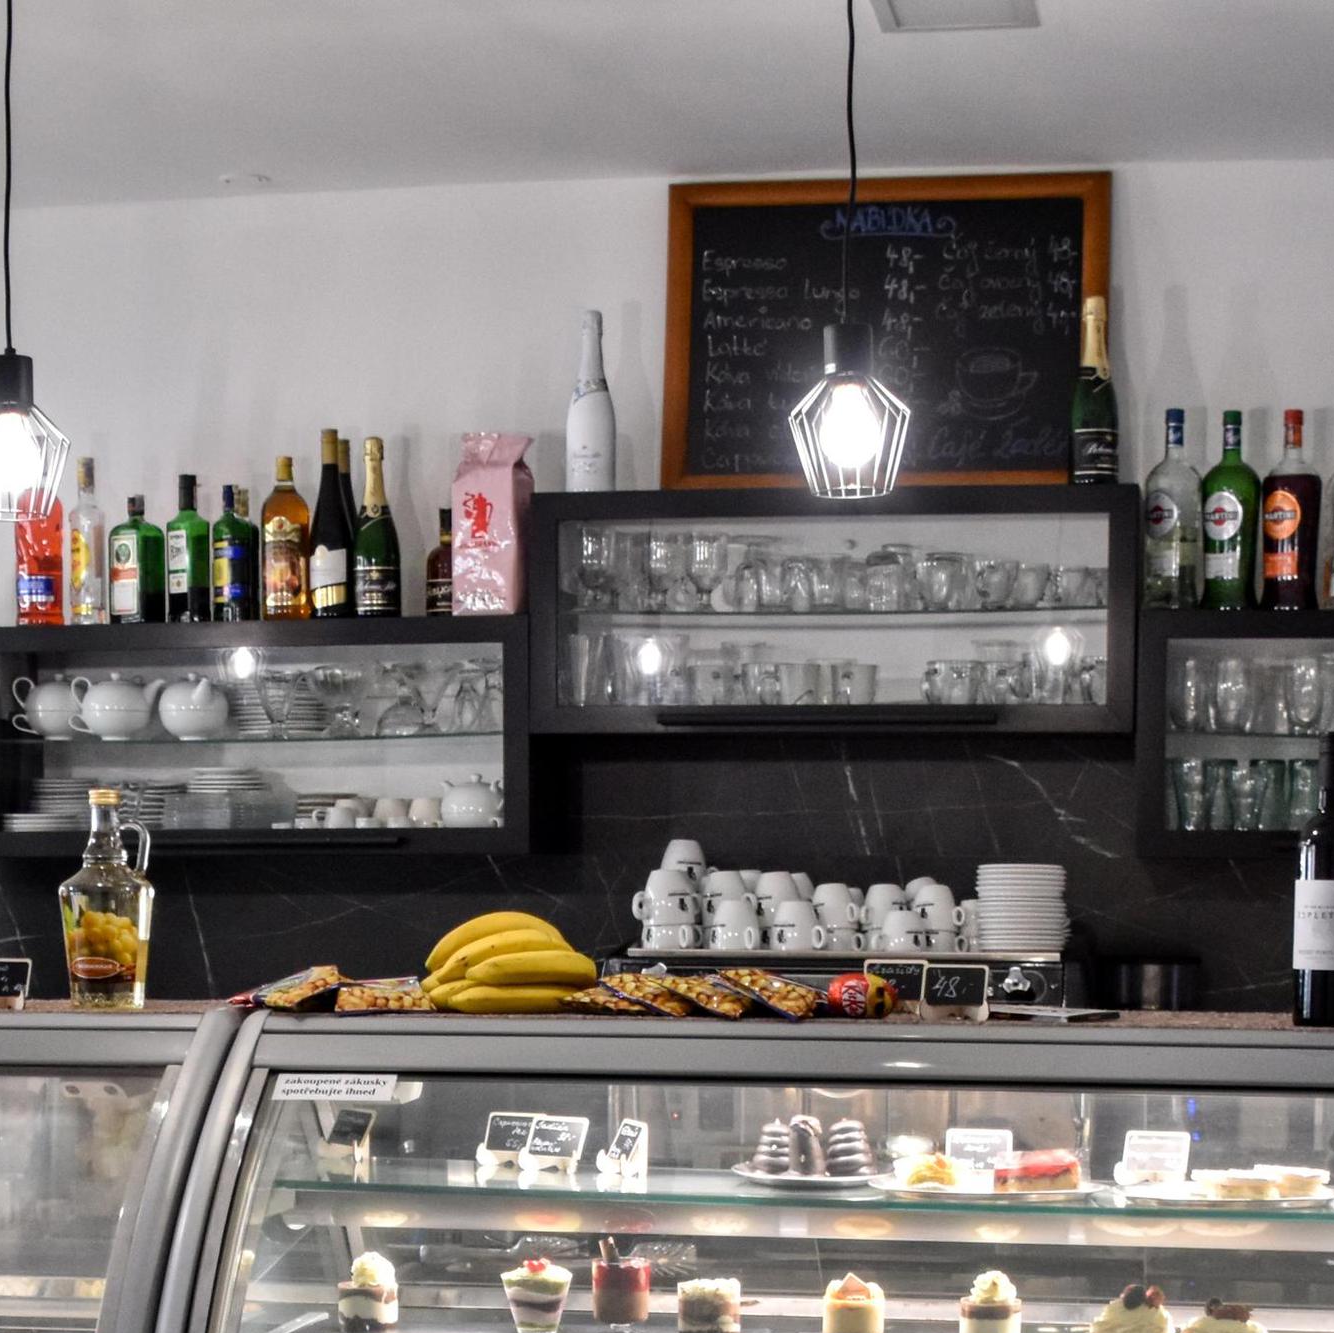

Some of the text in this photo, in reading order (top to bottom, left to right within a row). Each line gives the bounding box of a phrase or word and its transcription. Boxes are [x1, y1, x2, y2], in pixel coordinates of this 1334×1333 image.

[702, 249, 788, 277] Espresso
[702, 279, 788, 307] Espresso
[281, 1087, 377, 1097] spotřebujte ihned
[284, 1077, 388, 1088] zakoupené zákusky
